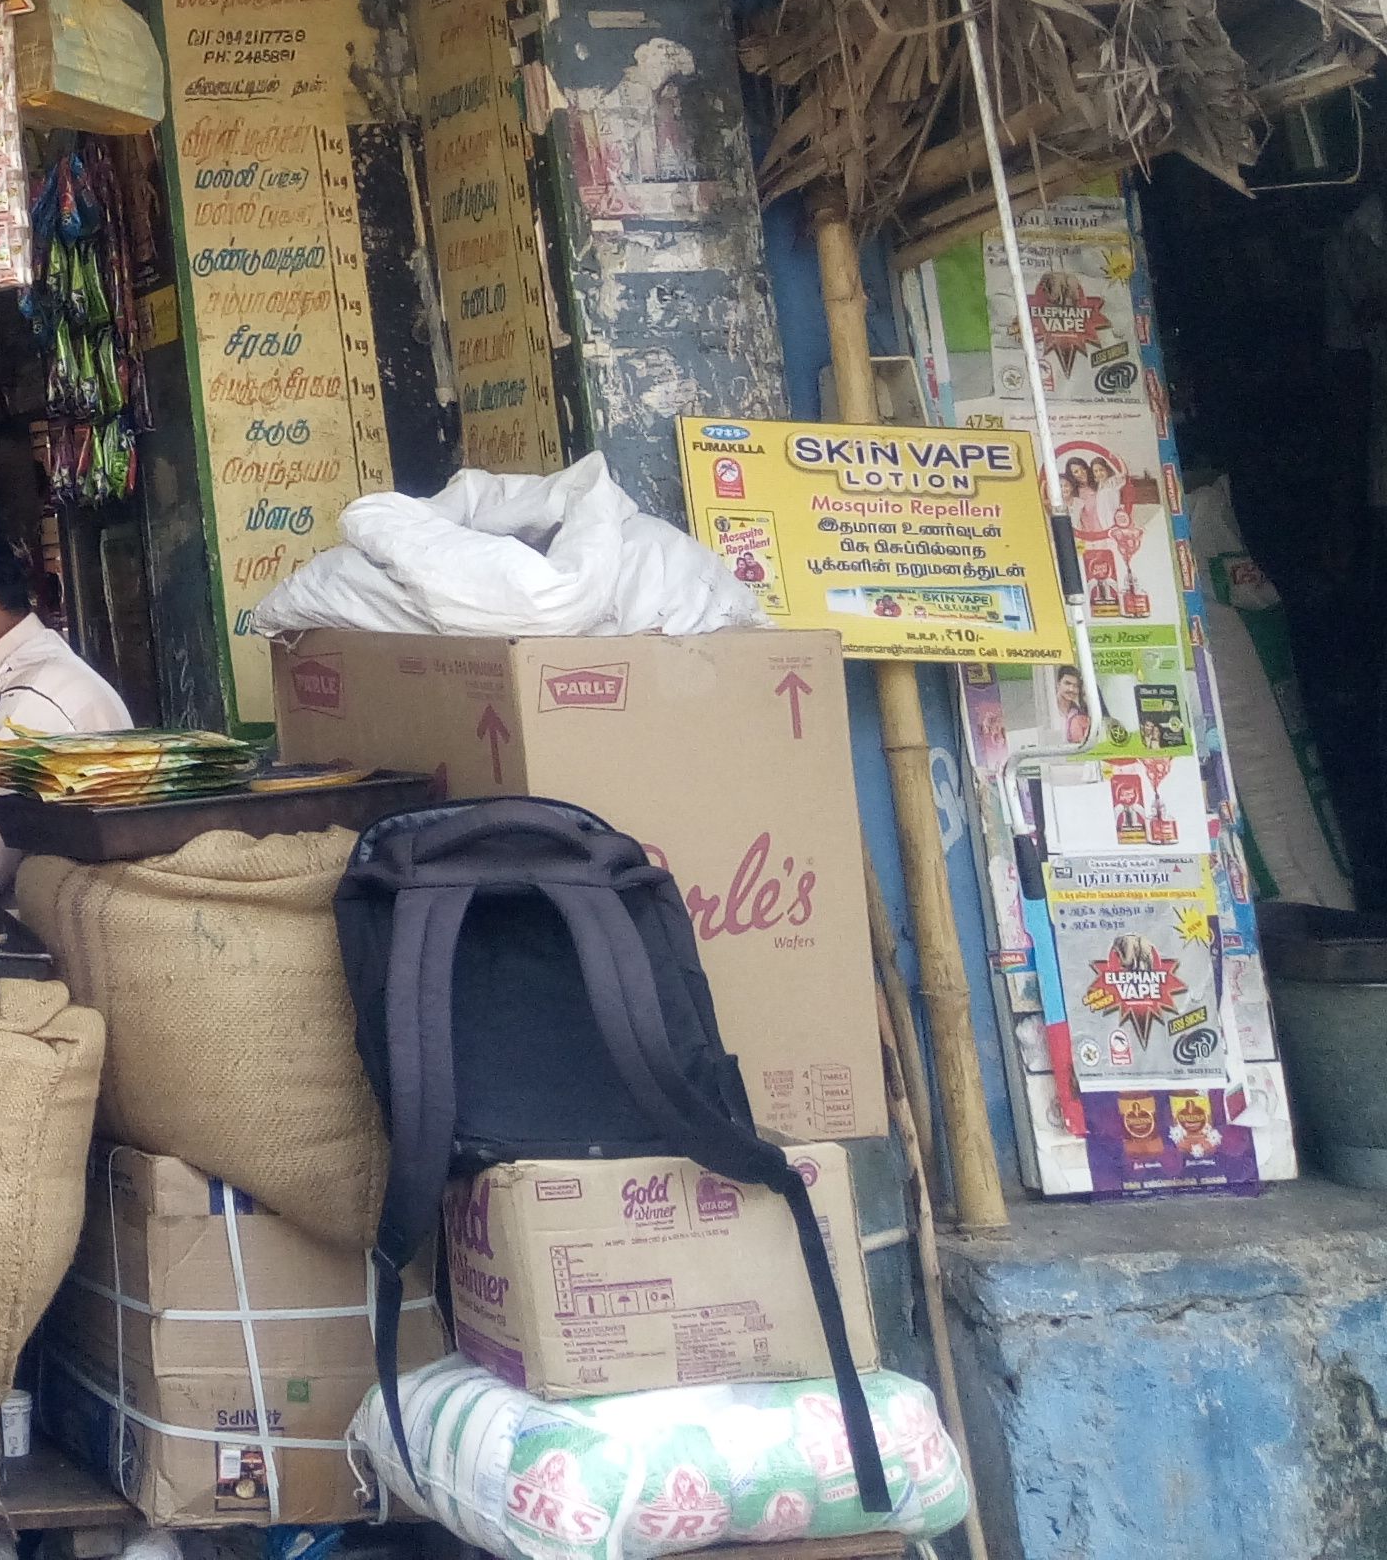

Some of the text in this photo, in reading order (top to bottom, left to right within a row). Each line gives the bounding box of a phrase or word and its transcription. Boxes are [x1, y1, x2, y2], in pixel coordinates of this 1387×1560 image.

[1030, 306, 1093, 318] ELEPHANT
[1042, 317, 1087, 333] VAPE
[224, 323, 304, 359] சீரகம்
[245, 419, 311, 447] கடுகு
[693, 436, 1013, 471] FUMAKILLA SKIN VAPE
[845, 470, 971, 489] LOTION
[811, 495, 1002, 519] Mosquito Repellent
[818, 517, 898, 534] இதமான
[922, 593, 990, 605] SKIN VAPE
[554, 679, 617, 697] PARLE
[773, 933, 817, 951] Wafers
[1104, 971, 1168, 985] ELEPHANT
[1117, 983, 1162, 1000] VAPE
[1194, 1042, 1211, 1058] 10
[621, 1172, 675, 1220] Gold
[505, 1482, 604, 1538] SRS
